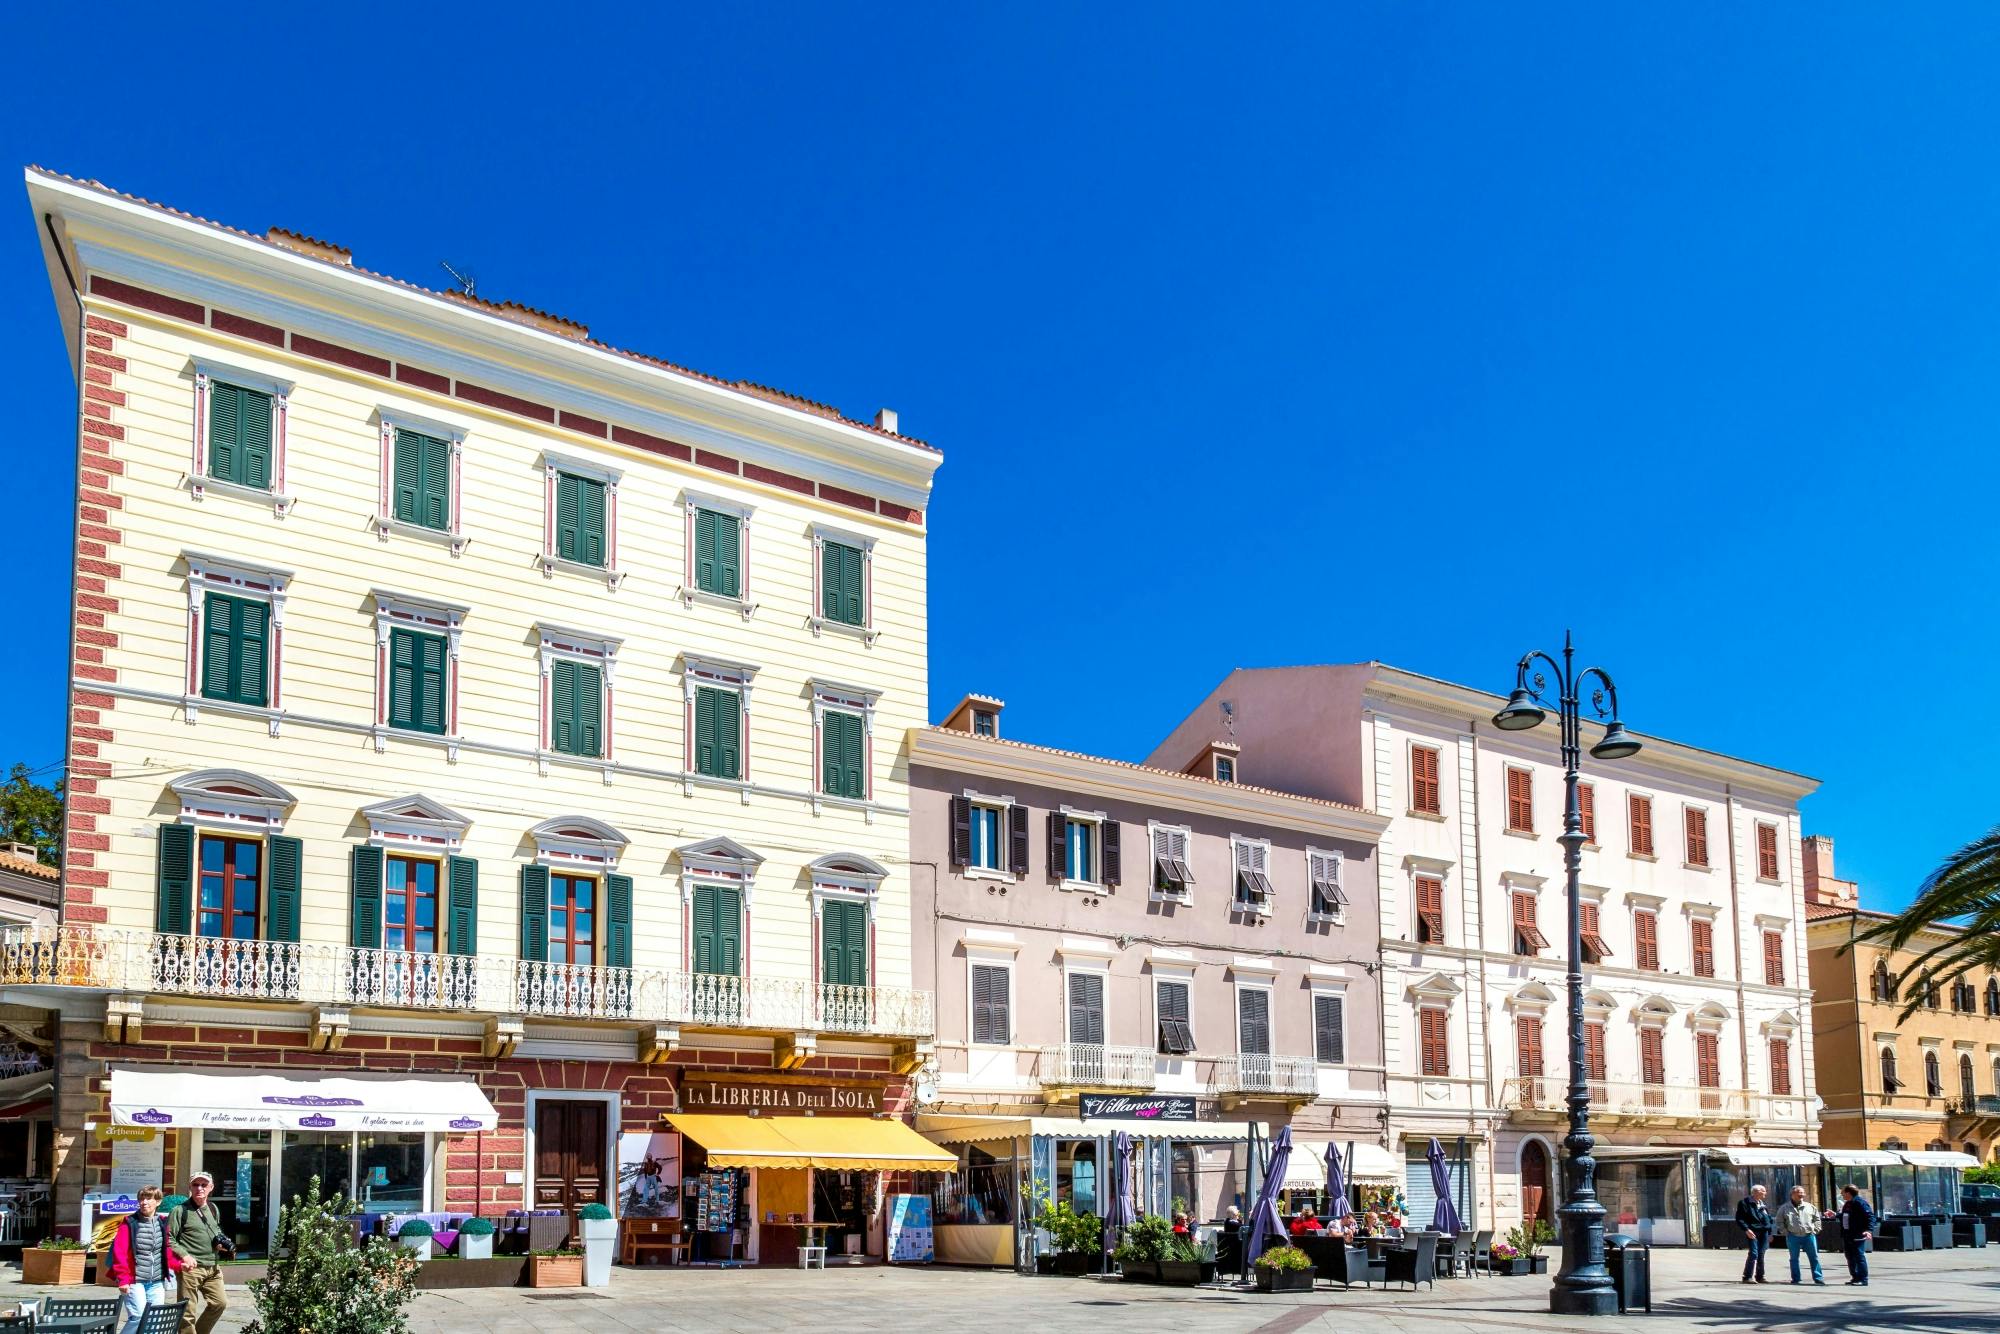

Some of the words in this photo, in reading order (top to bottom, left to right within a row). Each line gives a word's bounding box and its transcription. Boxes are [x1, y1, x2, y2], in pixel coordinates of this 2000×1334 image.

[688, 1087, 704, 1104] LA
[710, 1083, 790, 1107] LIBRERIA
[1091, 1097, 1166, 1114] Villanova
[1167, 1099, 1190, 1108] Bar
[211, 1112, 230, 1123] gelato
[258, 1113, 271, 1122] deve
[370, 1116, 388, 1126] gelato
[1283, 1180, 1316, 1188] ARTOLERIA
